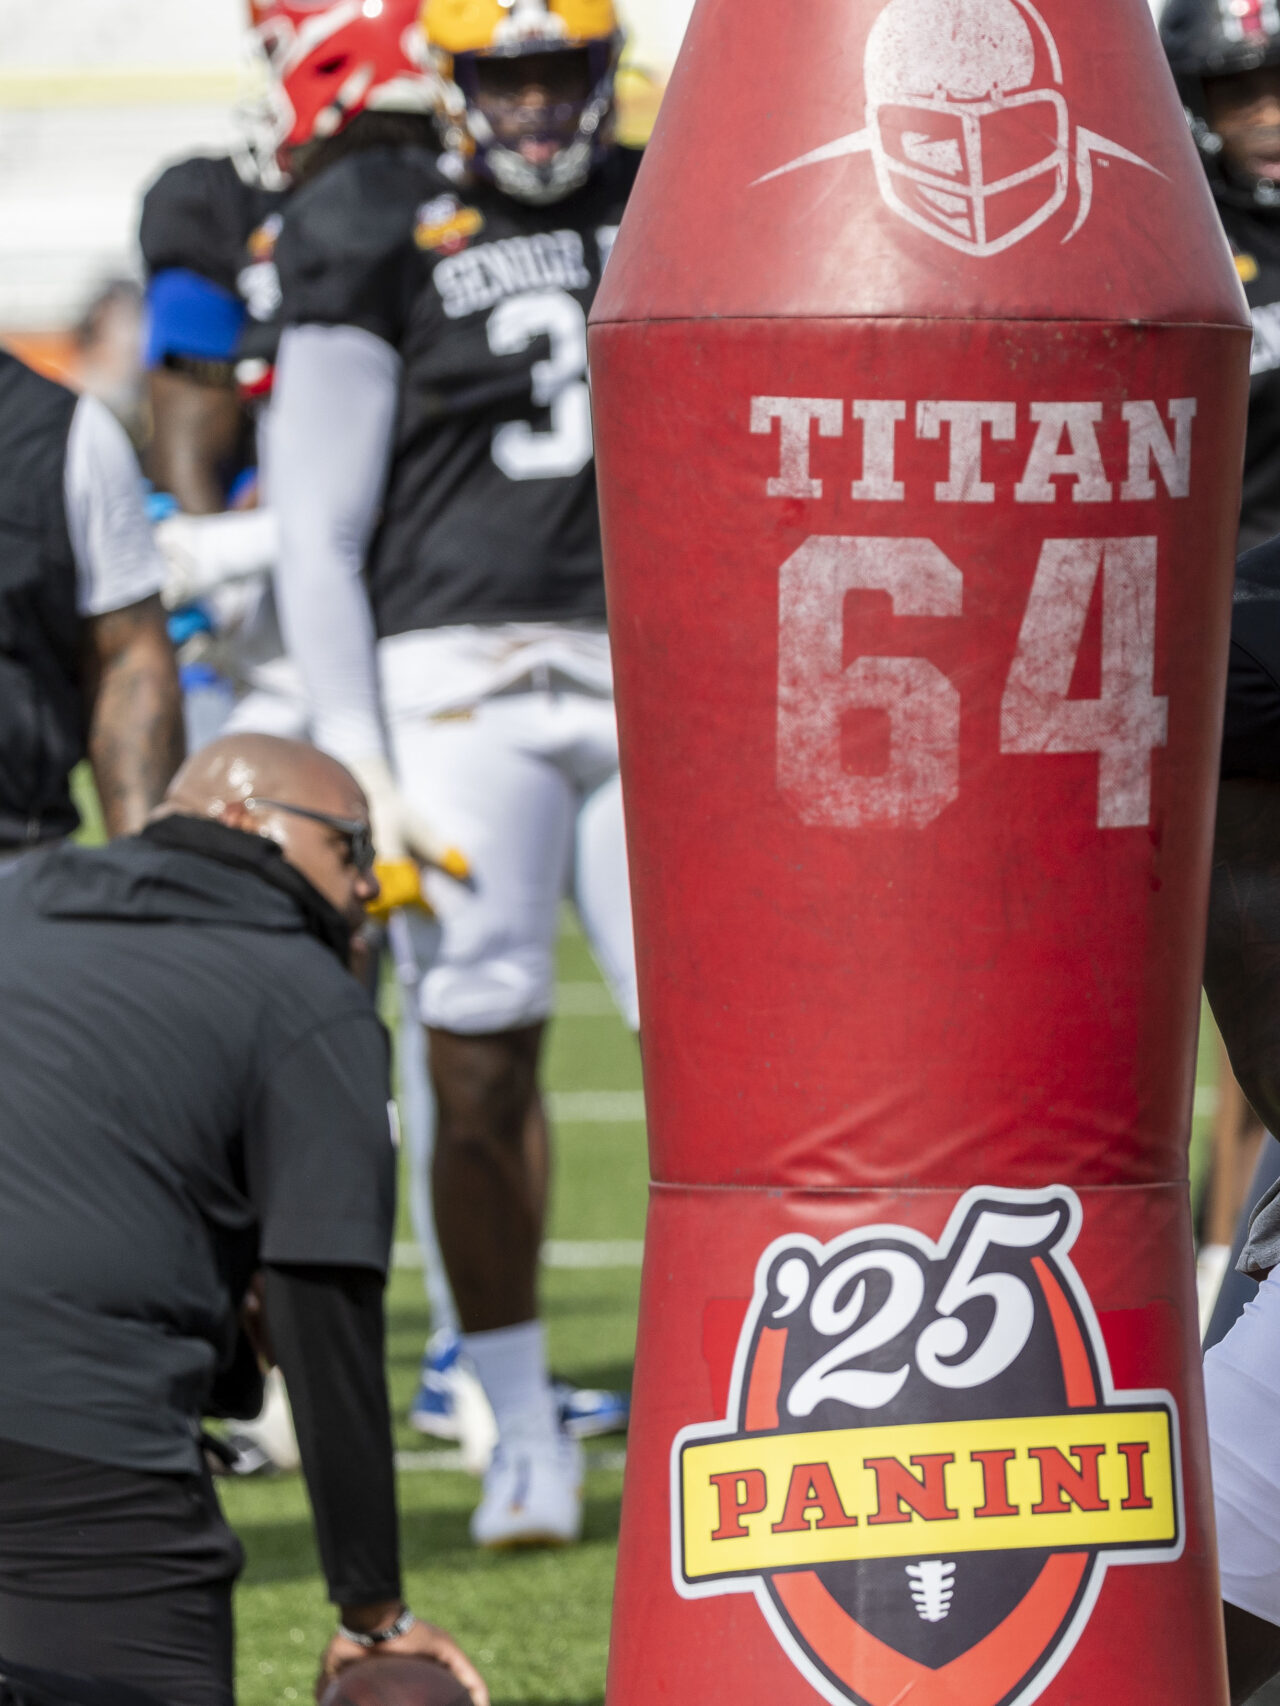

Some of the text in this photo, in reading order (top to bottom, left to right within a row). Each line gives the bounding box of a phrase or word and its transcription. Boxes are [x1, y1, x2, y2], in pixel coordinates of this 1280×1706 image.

[485, 286, 595, 481] 3
[750, 396, 1197, 502] TITAN
[776, 534, 1168, 829] 64
[771, 1209, 1062, 1417] '25
[708, 1440, 1154, 1542] PANINI
